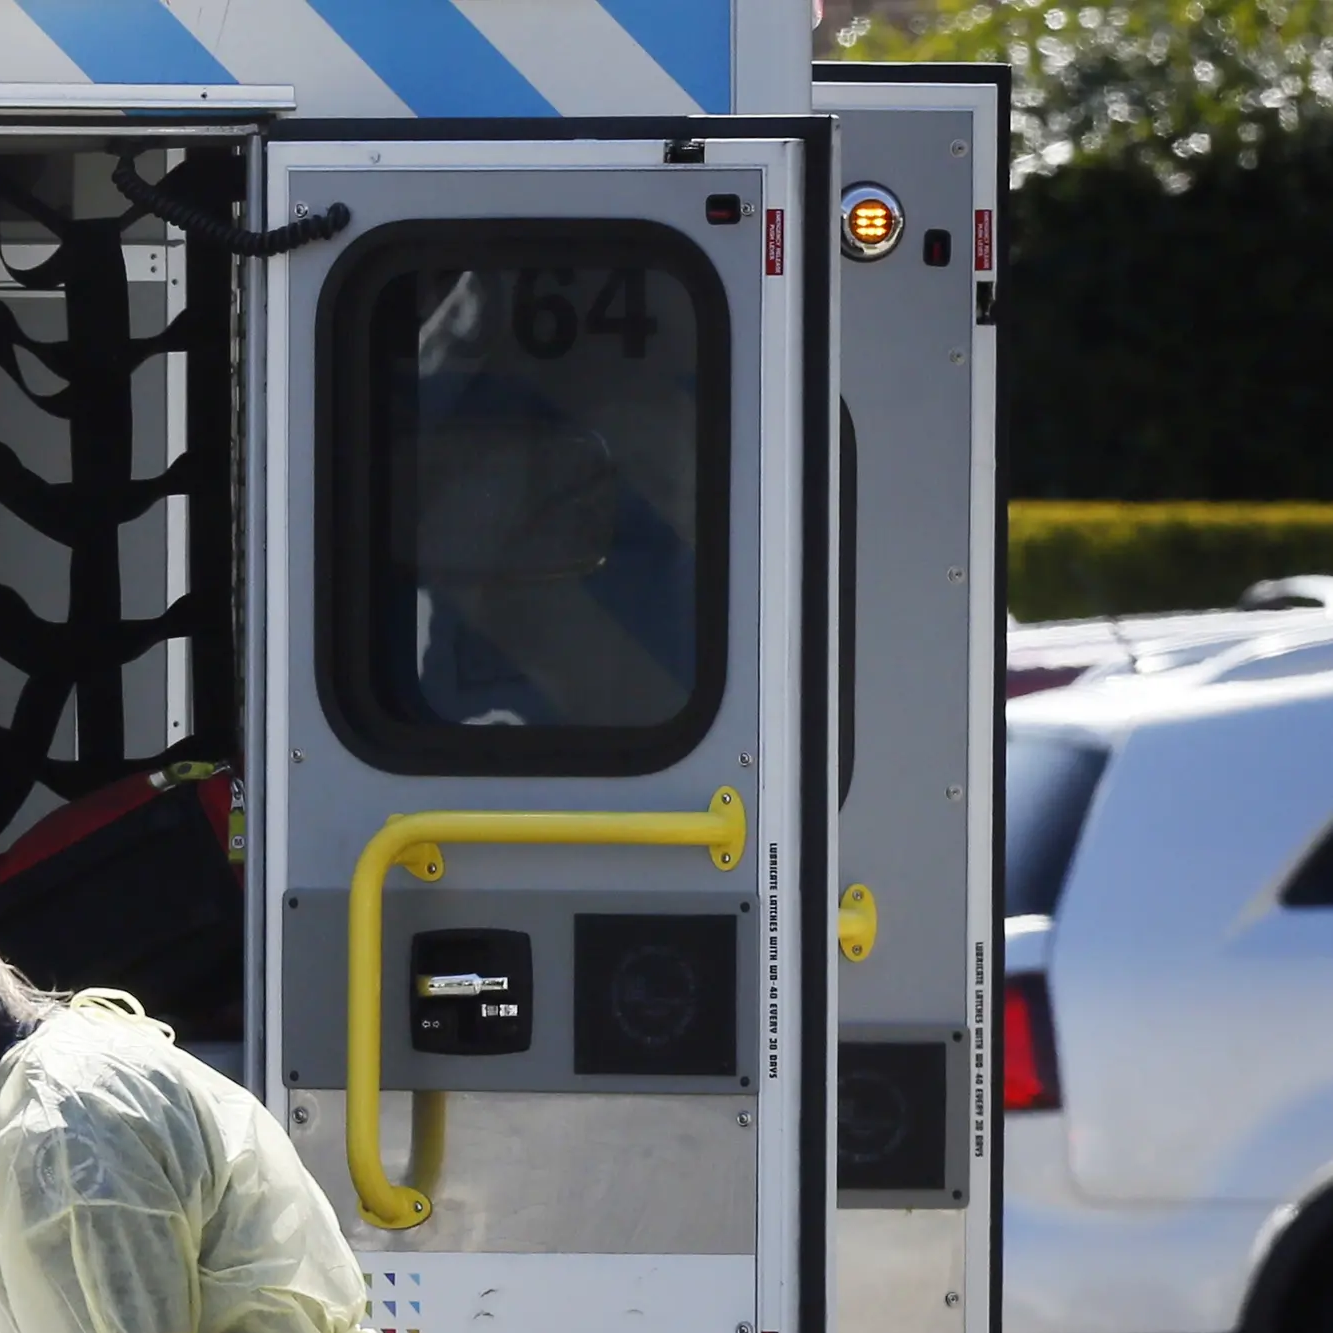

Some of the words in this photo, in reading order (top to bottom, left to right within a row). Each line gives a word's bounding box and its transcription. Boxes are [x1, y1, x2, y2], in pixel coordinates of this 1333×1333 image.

[769, 843, 778, 890] LUBRICATE
[769, 895, 778, 932] LATCHES
[769, 936, 778, 961] WITH
[769, 965, 778, 999] WD-40
[769, 1003, 778, 1034] EVERY
[769, 1038, 778, 1050] 30
[769, 1055, 778, 1079] DAYS
